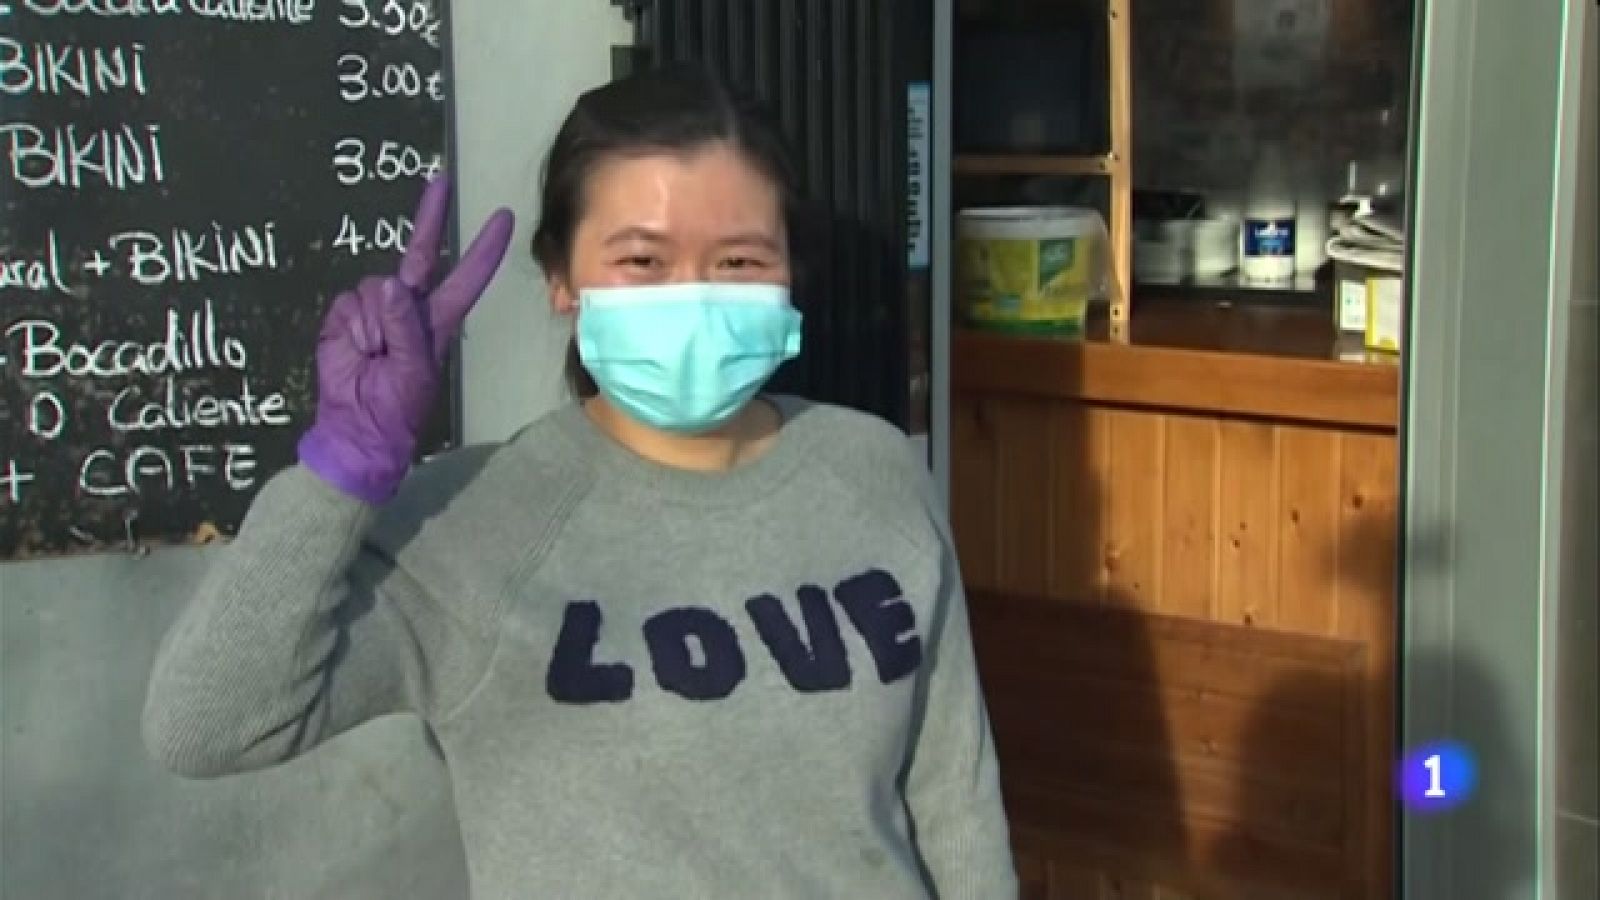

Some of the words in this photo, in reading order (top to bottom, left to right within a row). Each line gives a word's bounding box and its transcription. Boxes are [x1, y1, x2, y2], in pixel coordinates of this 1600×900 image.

[5, 298, 247, 376] Bocadillo
[108, 375, 291, 430] Caliente
[80, 444, 257, 495] CAFE
[546, 569, 922, 704] LOVE
